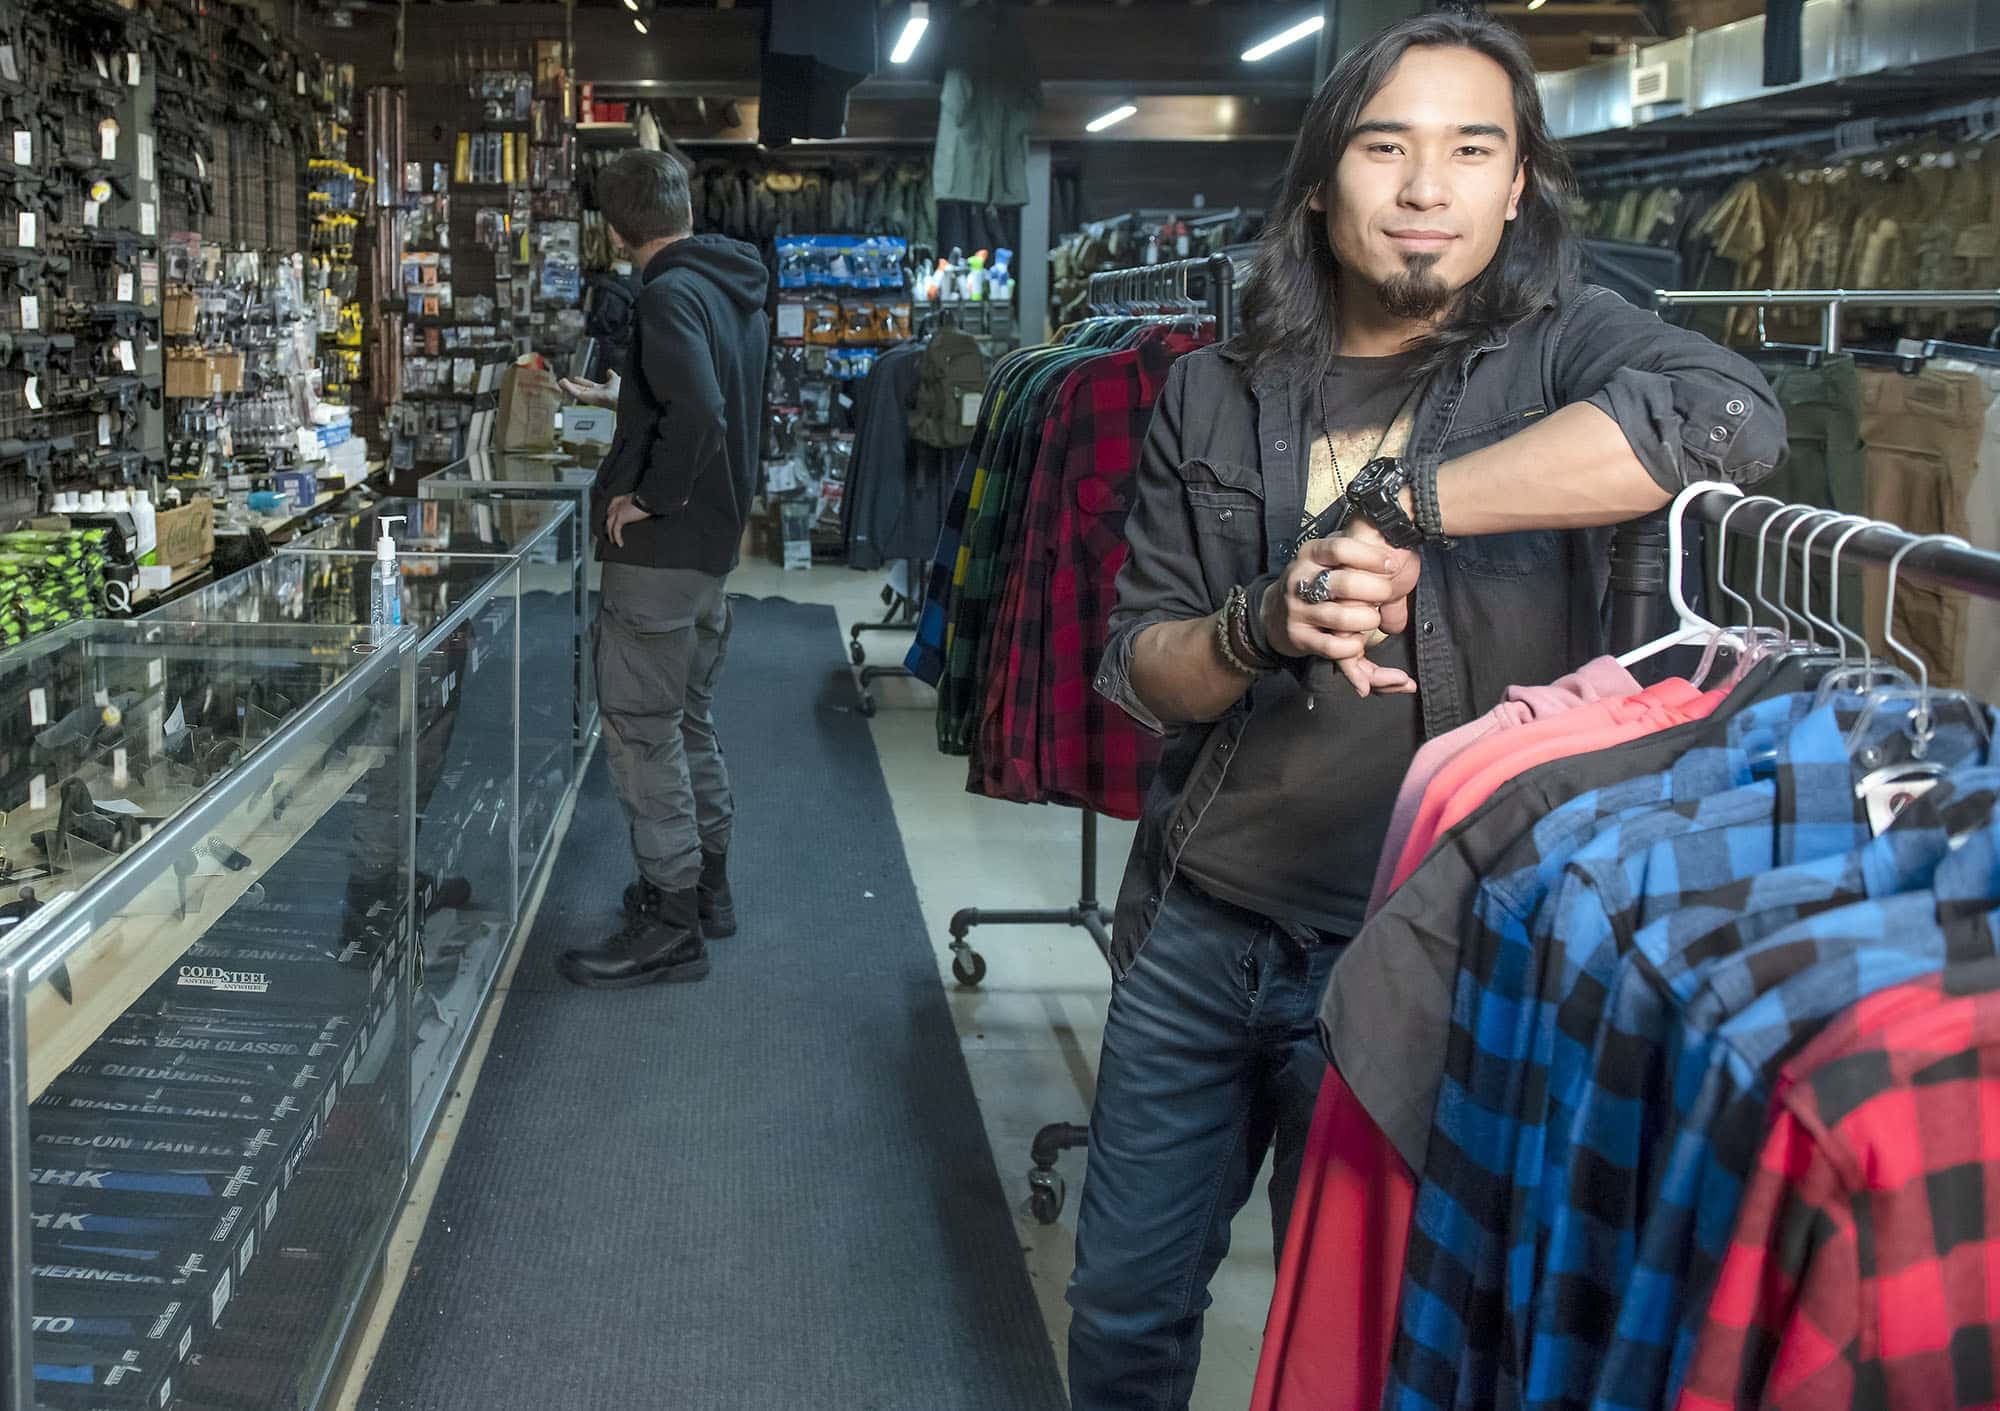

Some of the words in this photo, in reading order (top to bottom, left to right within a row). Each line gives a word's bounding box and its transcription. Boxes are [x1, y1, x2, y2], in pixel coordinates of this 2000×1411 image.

[103, 579, 132, 614] Q
[179, 965, 223, 978] COLD
[222, 972, 270, 984] STEEL
[155, 1037, 210, 1050] BEAR
